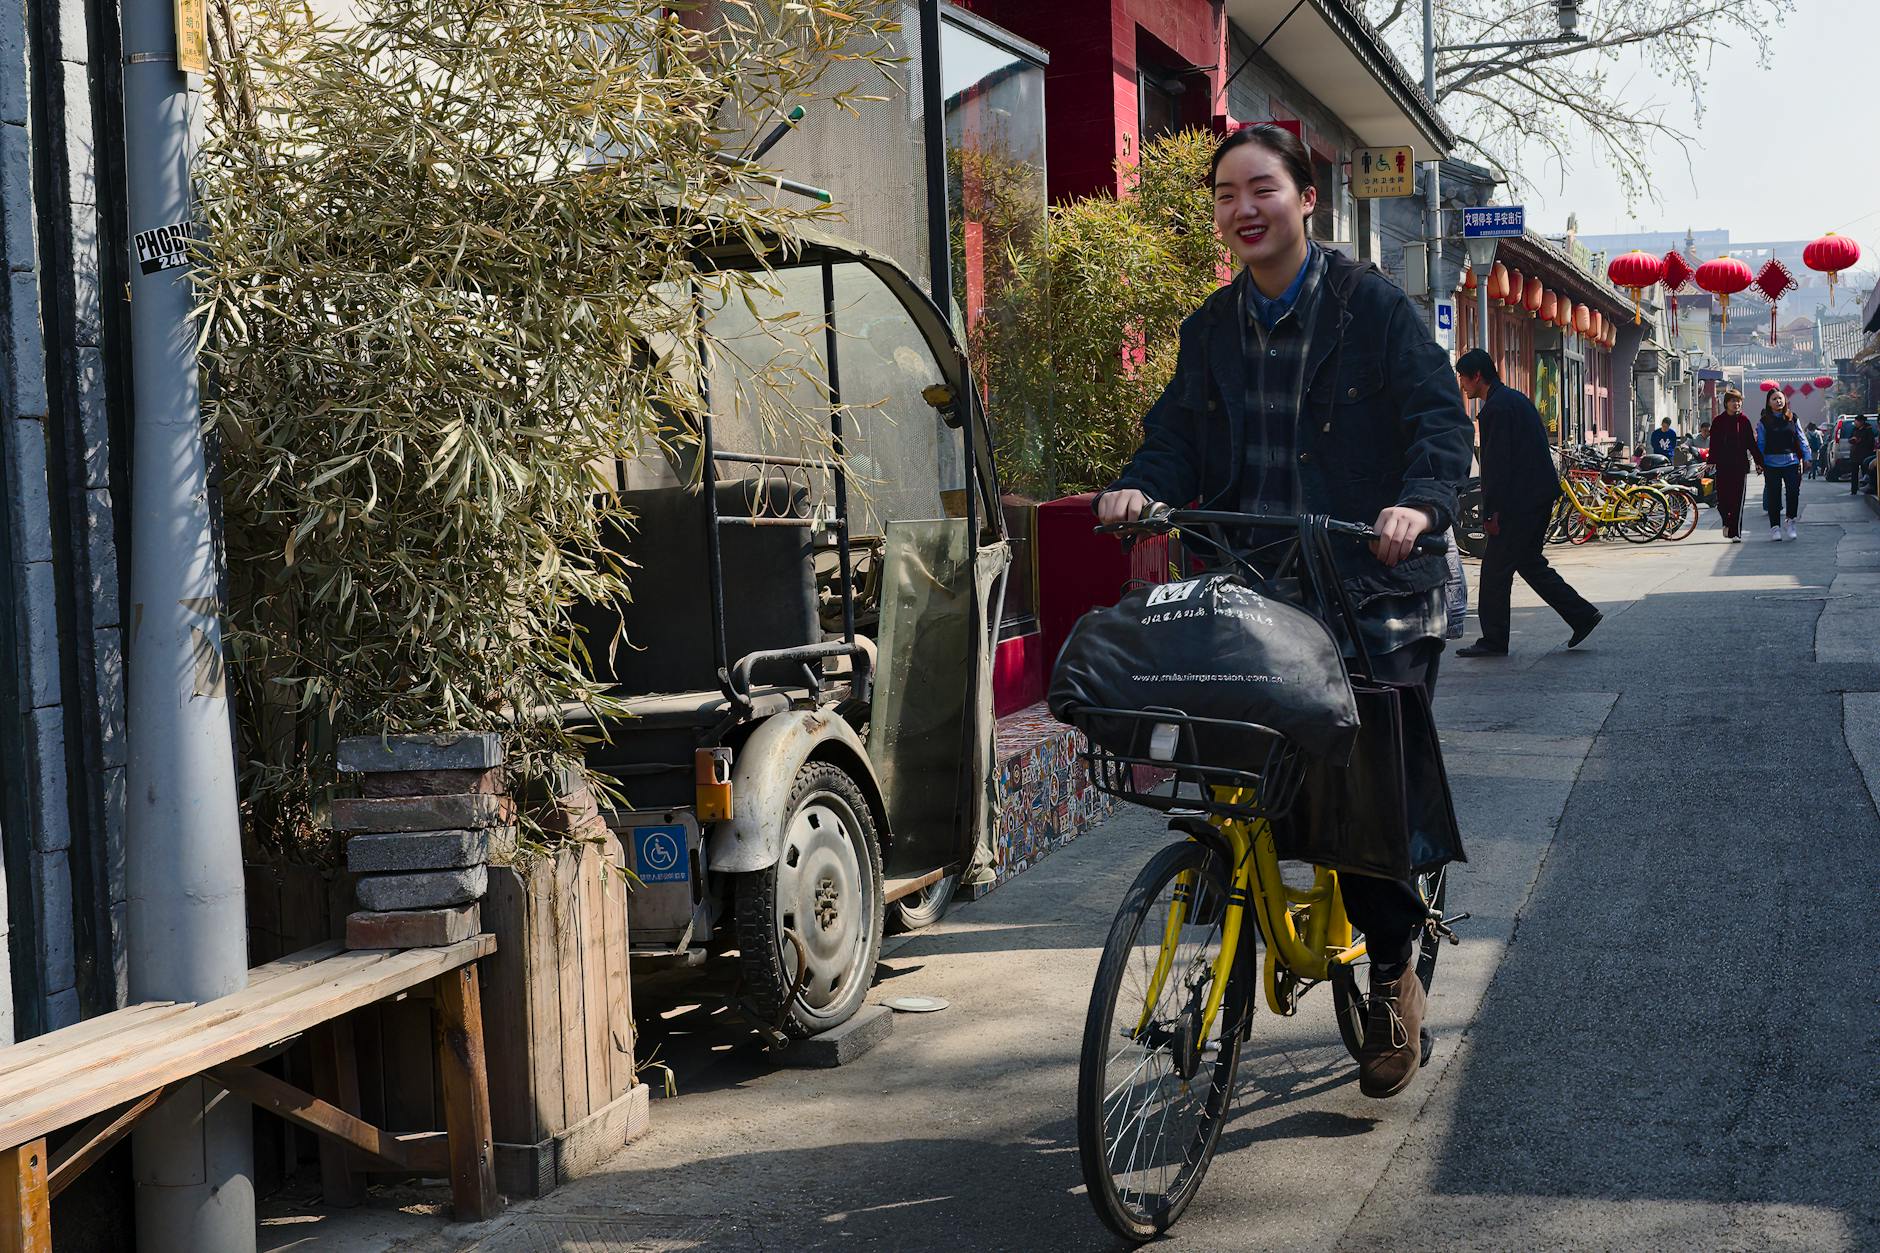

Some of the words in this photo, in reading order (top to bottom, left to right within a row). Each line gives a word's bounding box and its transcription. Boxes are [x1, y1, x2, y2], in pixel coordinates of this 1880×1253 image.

[1465, 212, 1493, 227] 文明停车
[1494, 211, 1522, 226] 平安出行
